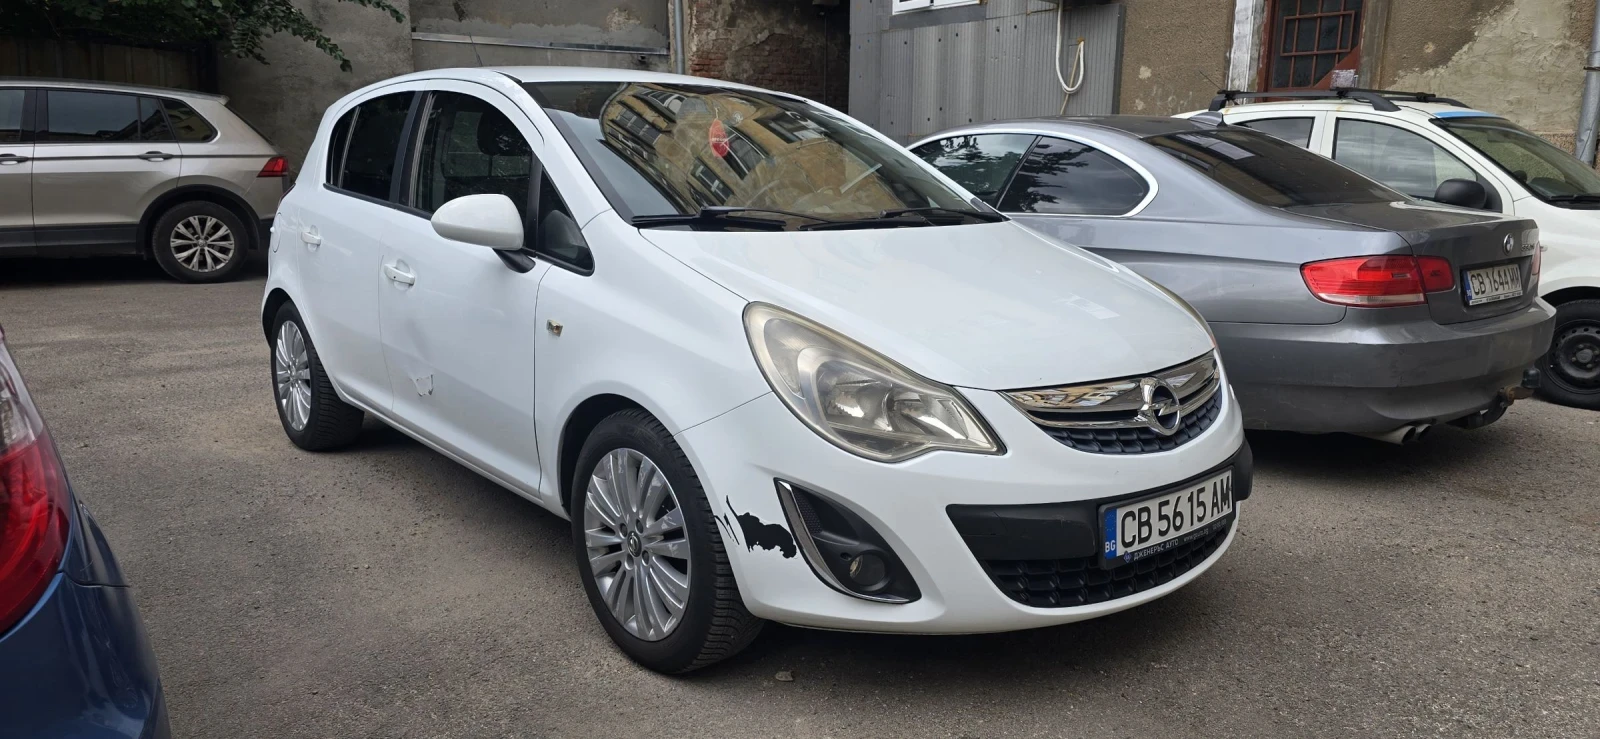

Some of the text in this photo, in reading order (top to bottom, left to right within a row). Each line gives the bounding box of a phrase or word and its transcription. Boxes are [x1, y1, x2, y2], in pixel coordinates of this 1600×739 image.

[1471, 273, 1486, 295] CB
[1487, 267, 1510, 293] 1644
[1121, 476, 1230, 548] CB 5615 AM
[1105, 540, 1116, 553] BG
